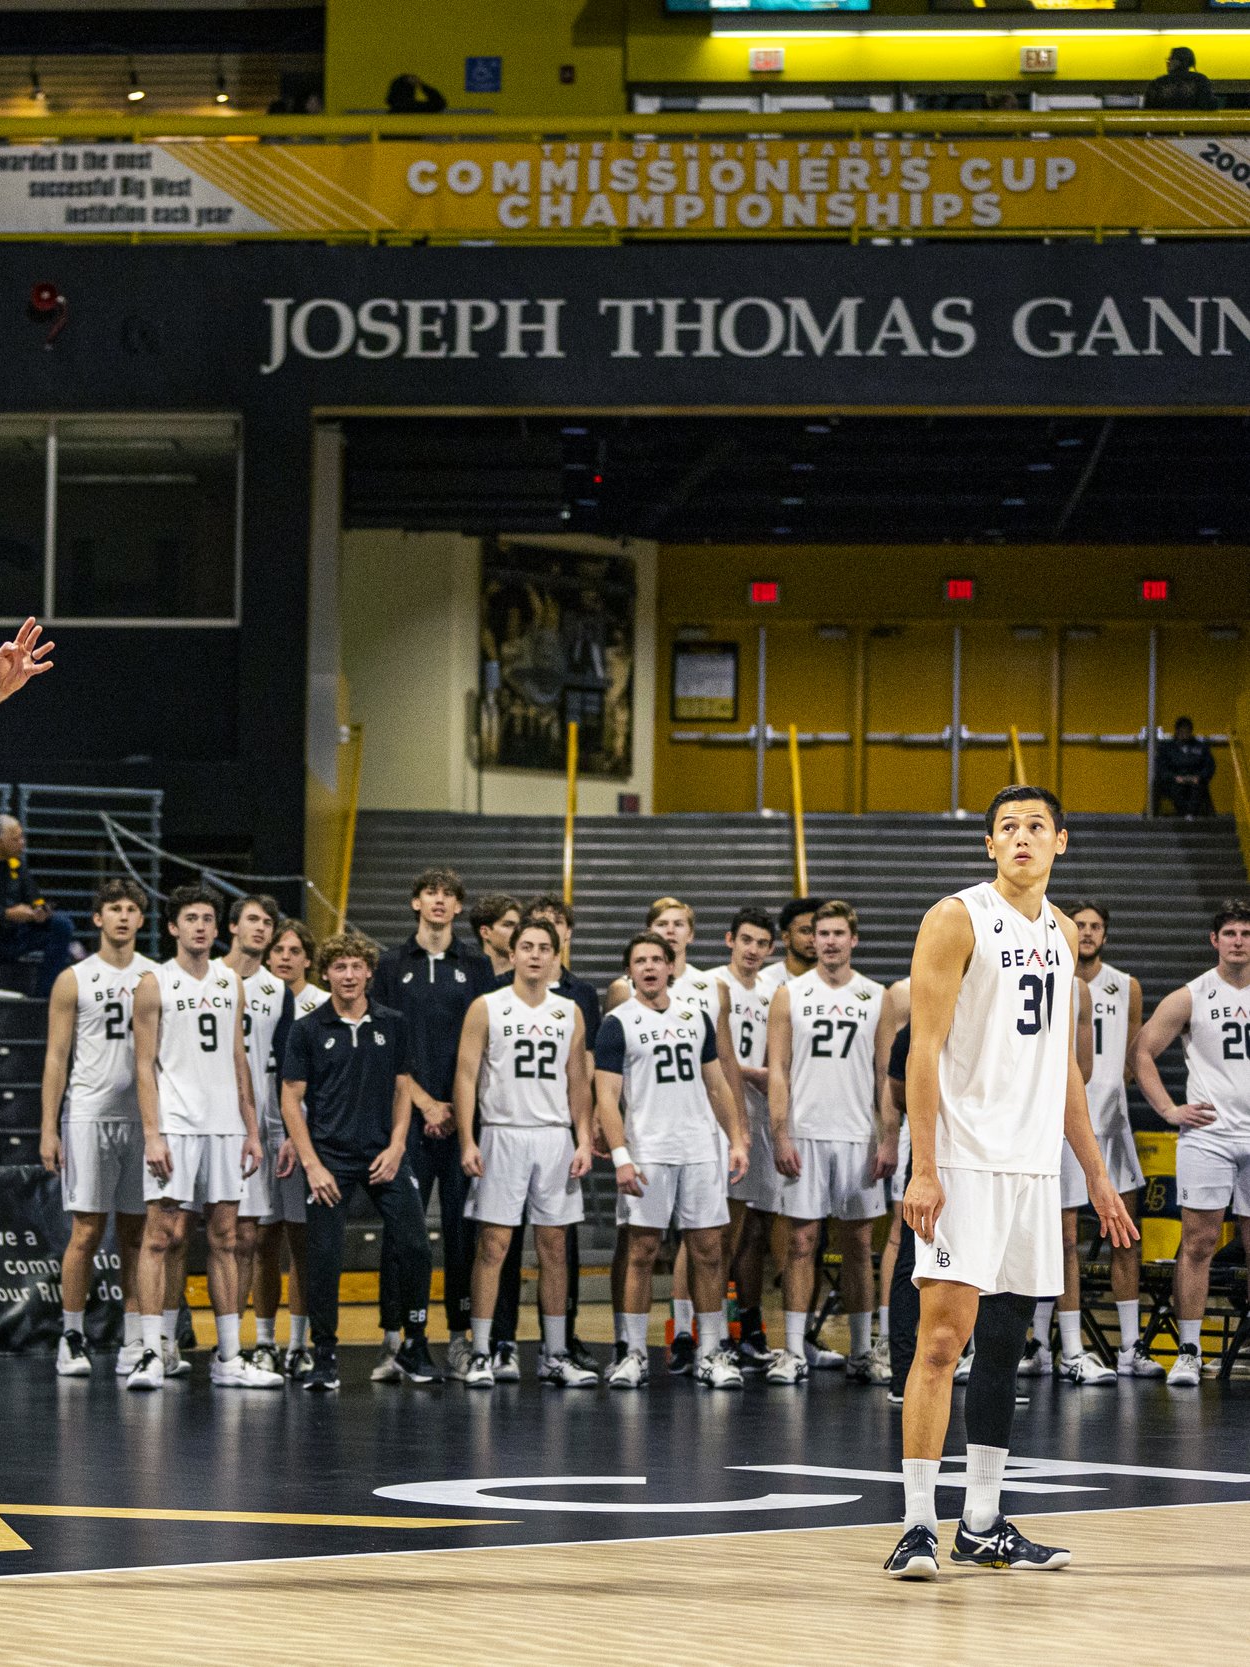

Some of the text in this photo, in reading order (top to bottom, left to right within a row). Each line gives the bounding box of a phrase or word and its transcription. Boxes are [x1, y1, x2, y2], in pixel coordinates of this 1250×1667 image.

[62, 151, 78, 170] to
[82, 151, 108, 170] the
[113, 151, 152, 170] most
[407, 157, 1077, 194] COMMISSIONER'S CUP
[1199, 143, 1250, 190] 200
[29, 177, 192, 200] successful Big West
[65, 203, 233, 228] institution each year
[498, 193, 1003, 229] CHAMPIONSHIPS
[260, 298, 566, 374] JOSEPH
[599, 296, 976, 359] THOMAS
[176, 996, 233, 1012] BEACH
[803, 1005, 867, 1021] BEACH
[1016, 972, 1054, 1035] 31
[198, 1013, 219, 1053] 9
[504, 1024, 565, 1039] BEACH
[639, 1027, 698, 1044] BEACH
[810, 1019, 859, 1059] 27
[514, 1039, 558, 1081] 22
[653, 1042, 695, 1085] 26
[24, 1230, 38, 1246] a
[936, 1247, 951, 1267] LB
